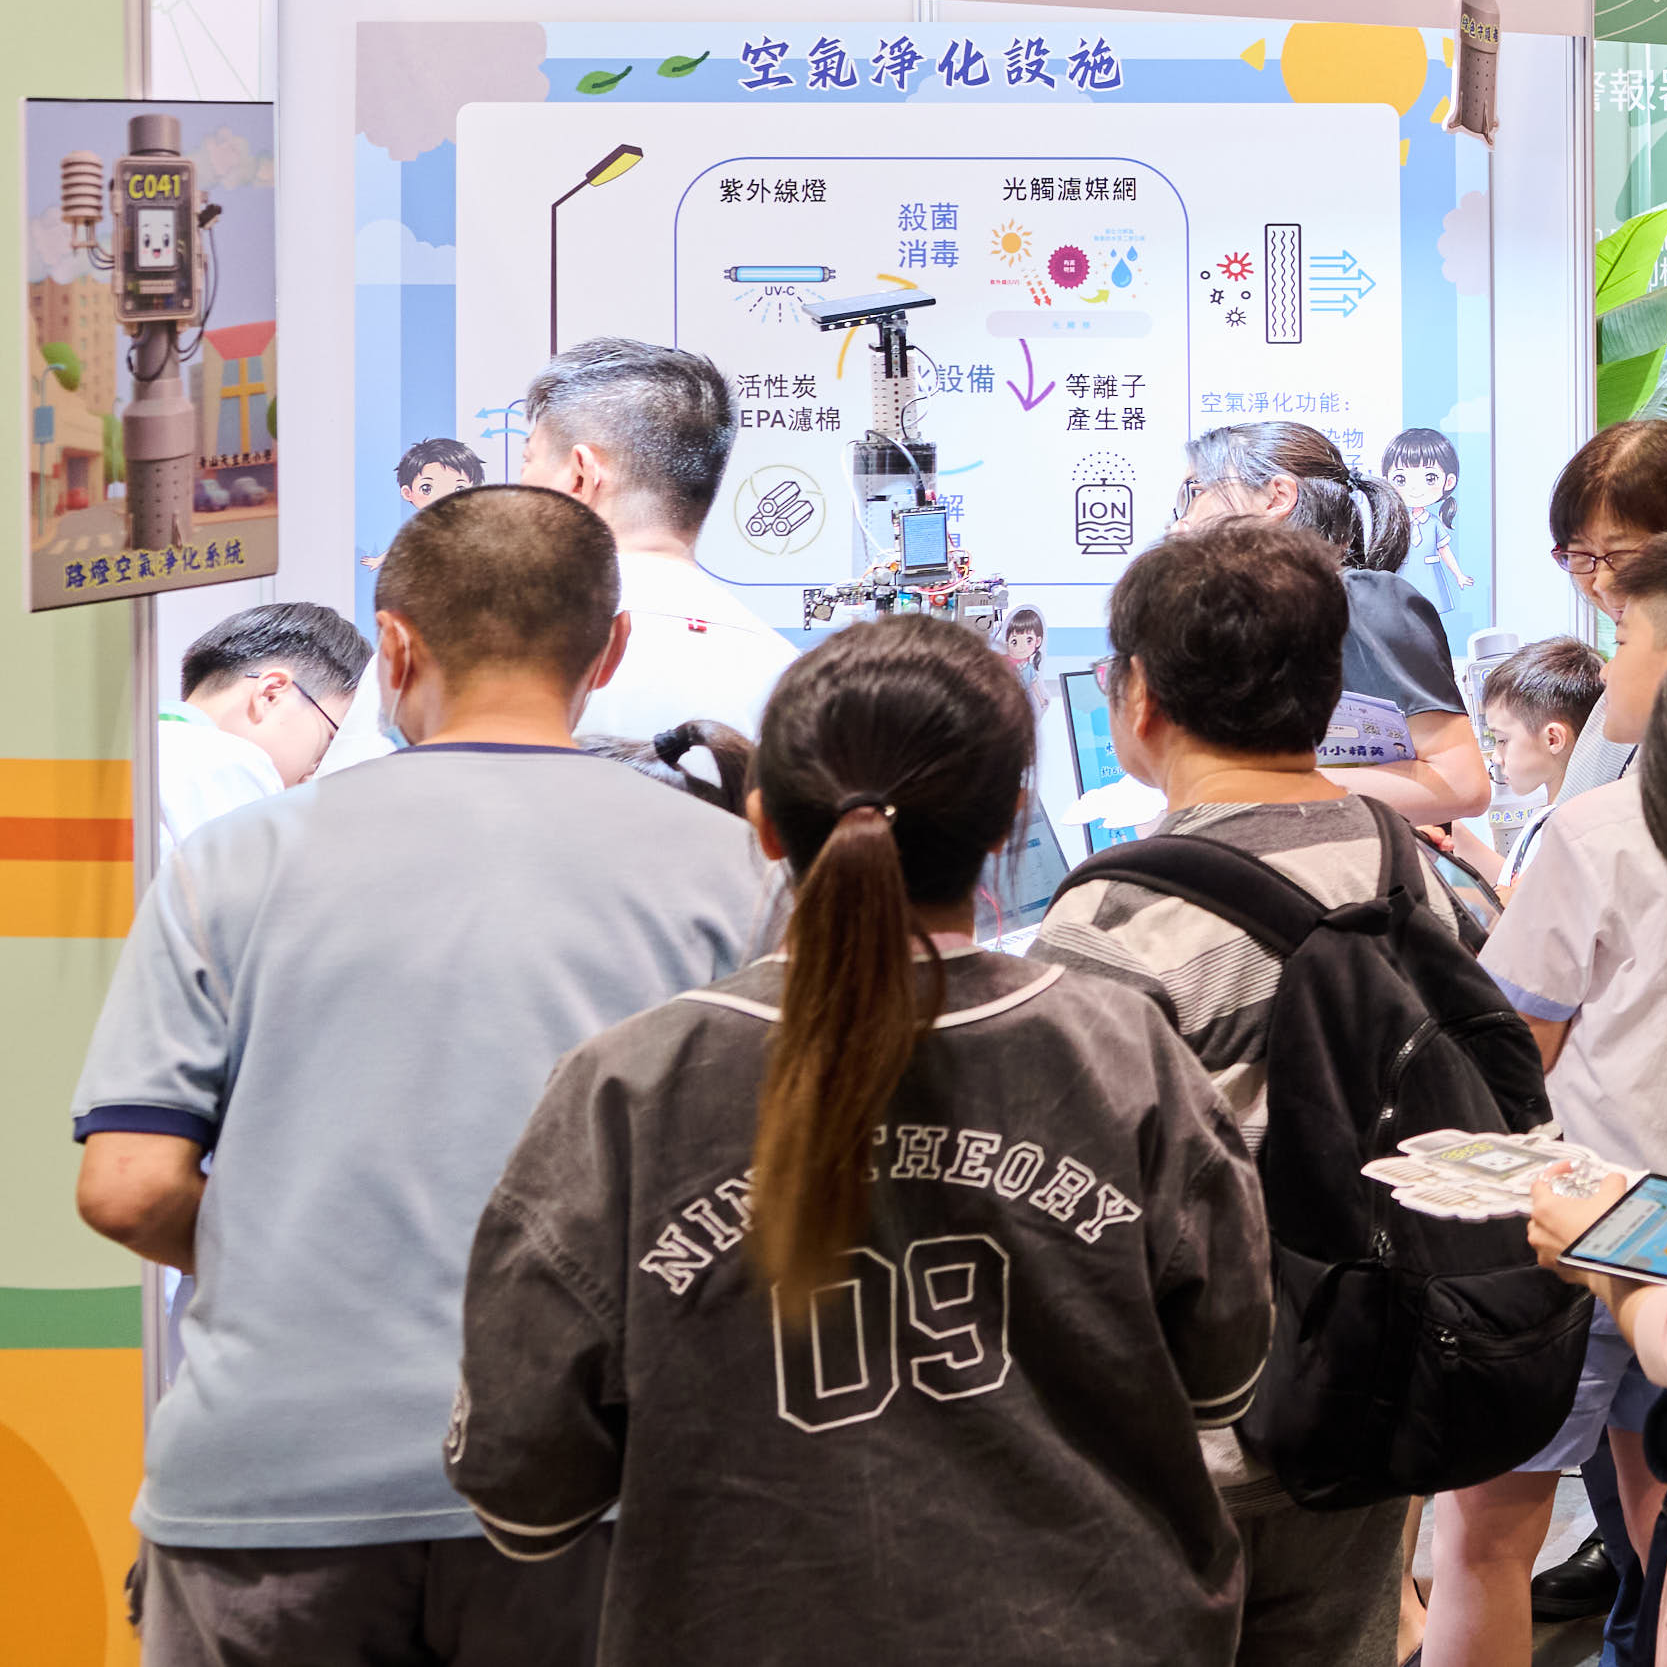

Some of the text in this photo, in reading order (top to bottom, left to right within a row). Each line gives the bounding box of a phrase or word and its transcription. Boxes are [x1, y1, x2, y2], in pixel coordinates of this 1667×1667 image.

[738, 35, 1123, 92] 空氣淨化設施
[128, 173, 181, 200] C041
[719, 178, 828, 204] 紫外線燈
[1003, 176, 1137, 201] 光觸濾媒網
[897, 202, 960, 231] 殺菌
[897, 240, 960, 269] 消毒
[764, 285, 796, 297] UV-C
[736, 373, 818, 399] 活性炭
[1065, 373, 1146, 400] 等離子
[740, 407, 842, 432] EPA濾棉
[1066, 407, 1147, 432] 產生器
[1082, 502, 1126, 519] ION
[64, 539, 246, 591] 路燈空氣淨化系統
[872, 1126, 1141, 1244] HEORY
[772, 1233, 1011, 1434] 09
